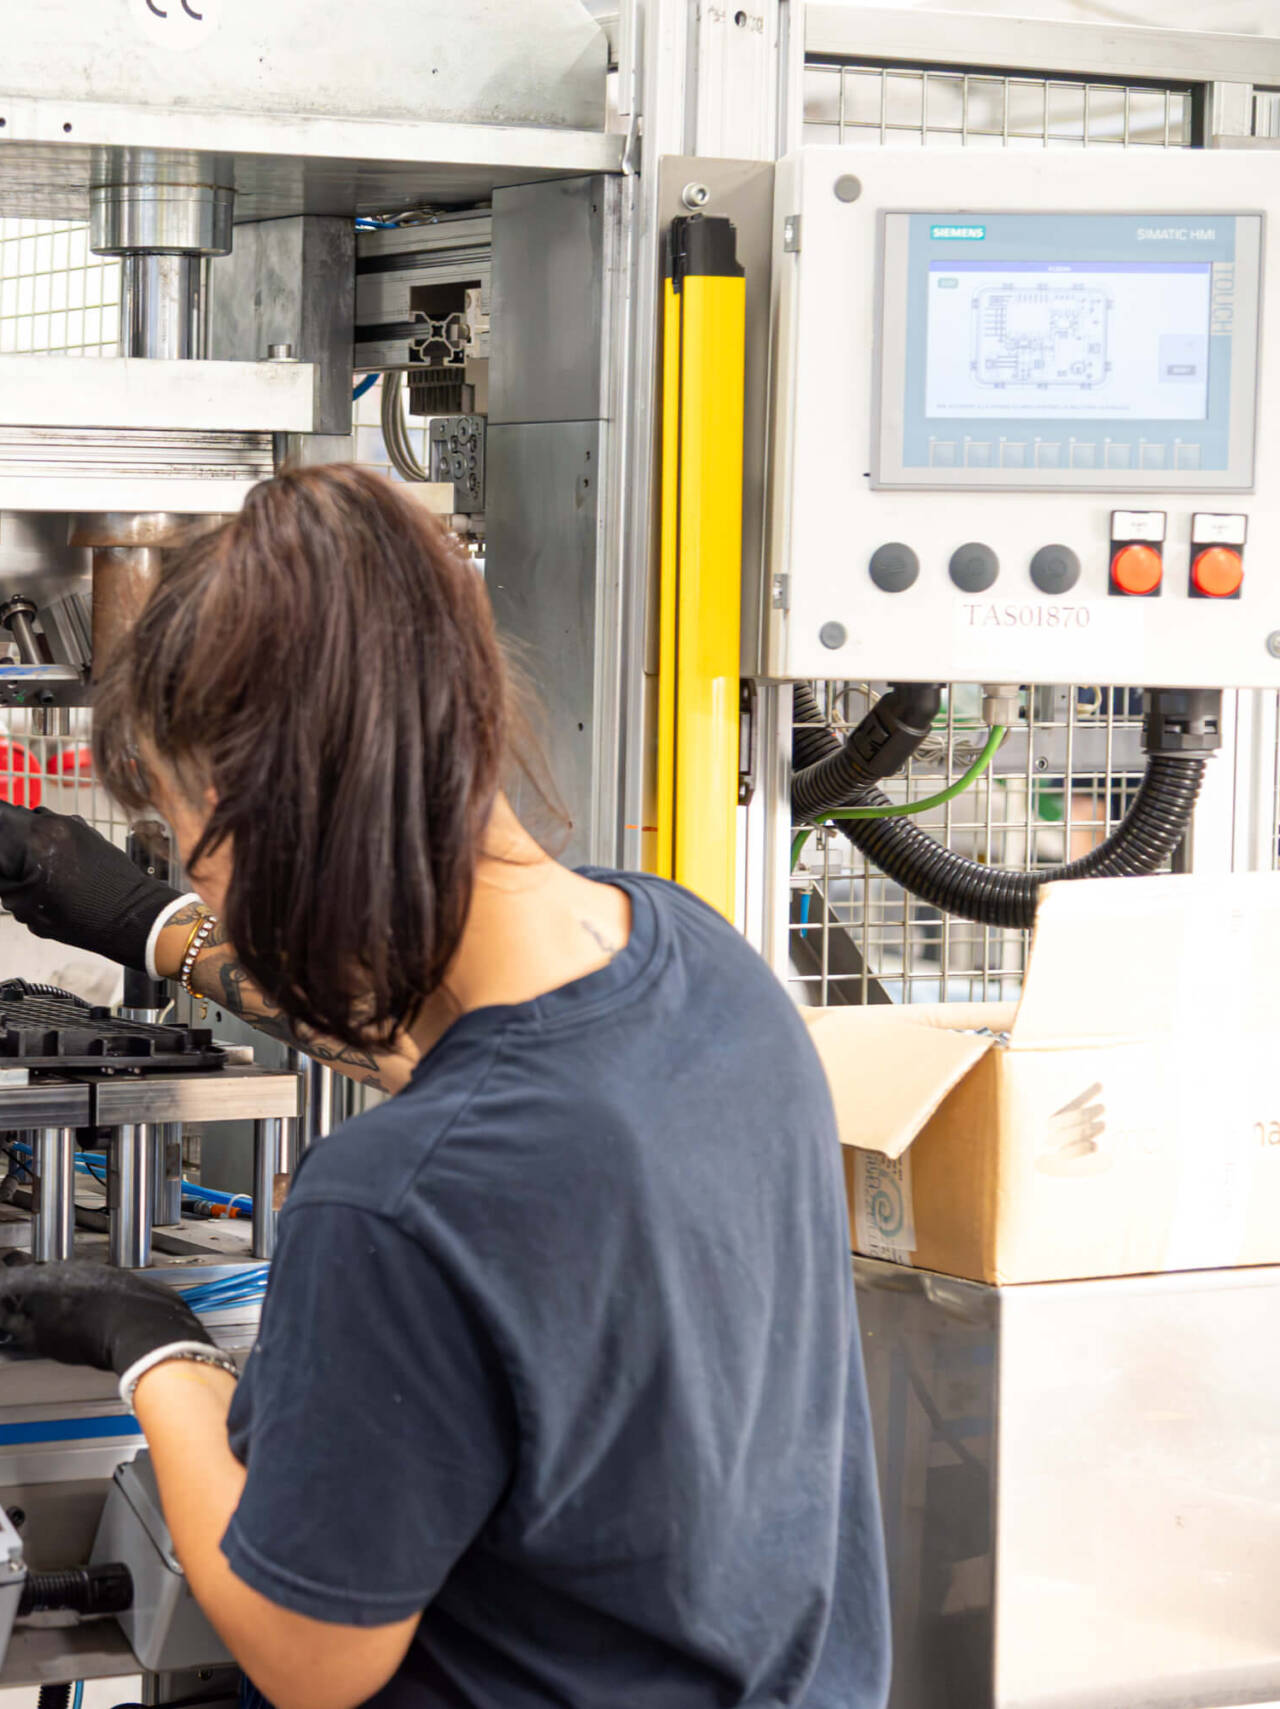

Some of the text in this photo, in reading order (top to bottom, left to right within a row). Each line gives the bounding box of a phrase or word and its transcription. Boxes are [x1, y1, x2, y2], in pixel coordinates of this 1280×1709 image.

[932, 226, 984, 239] SIEMENS
[1136, 228, 1216, 241] SIMATIC HMI
[1214, 263, 1235, 334] TOUCH
[962, 604, 1090, 628] TAS01870
